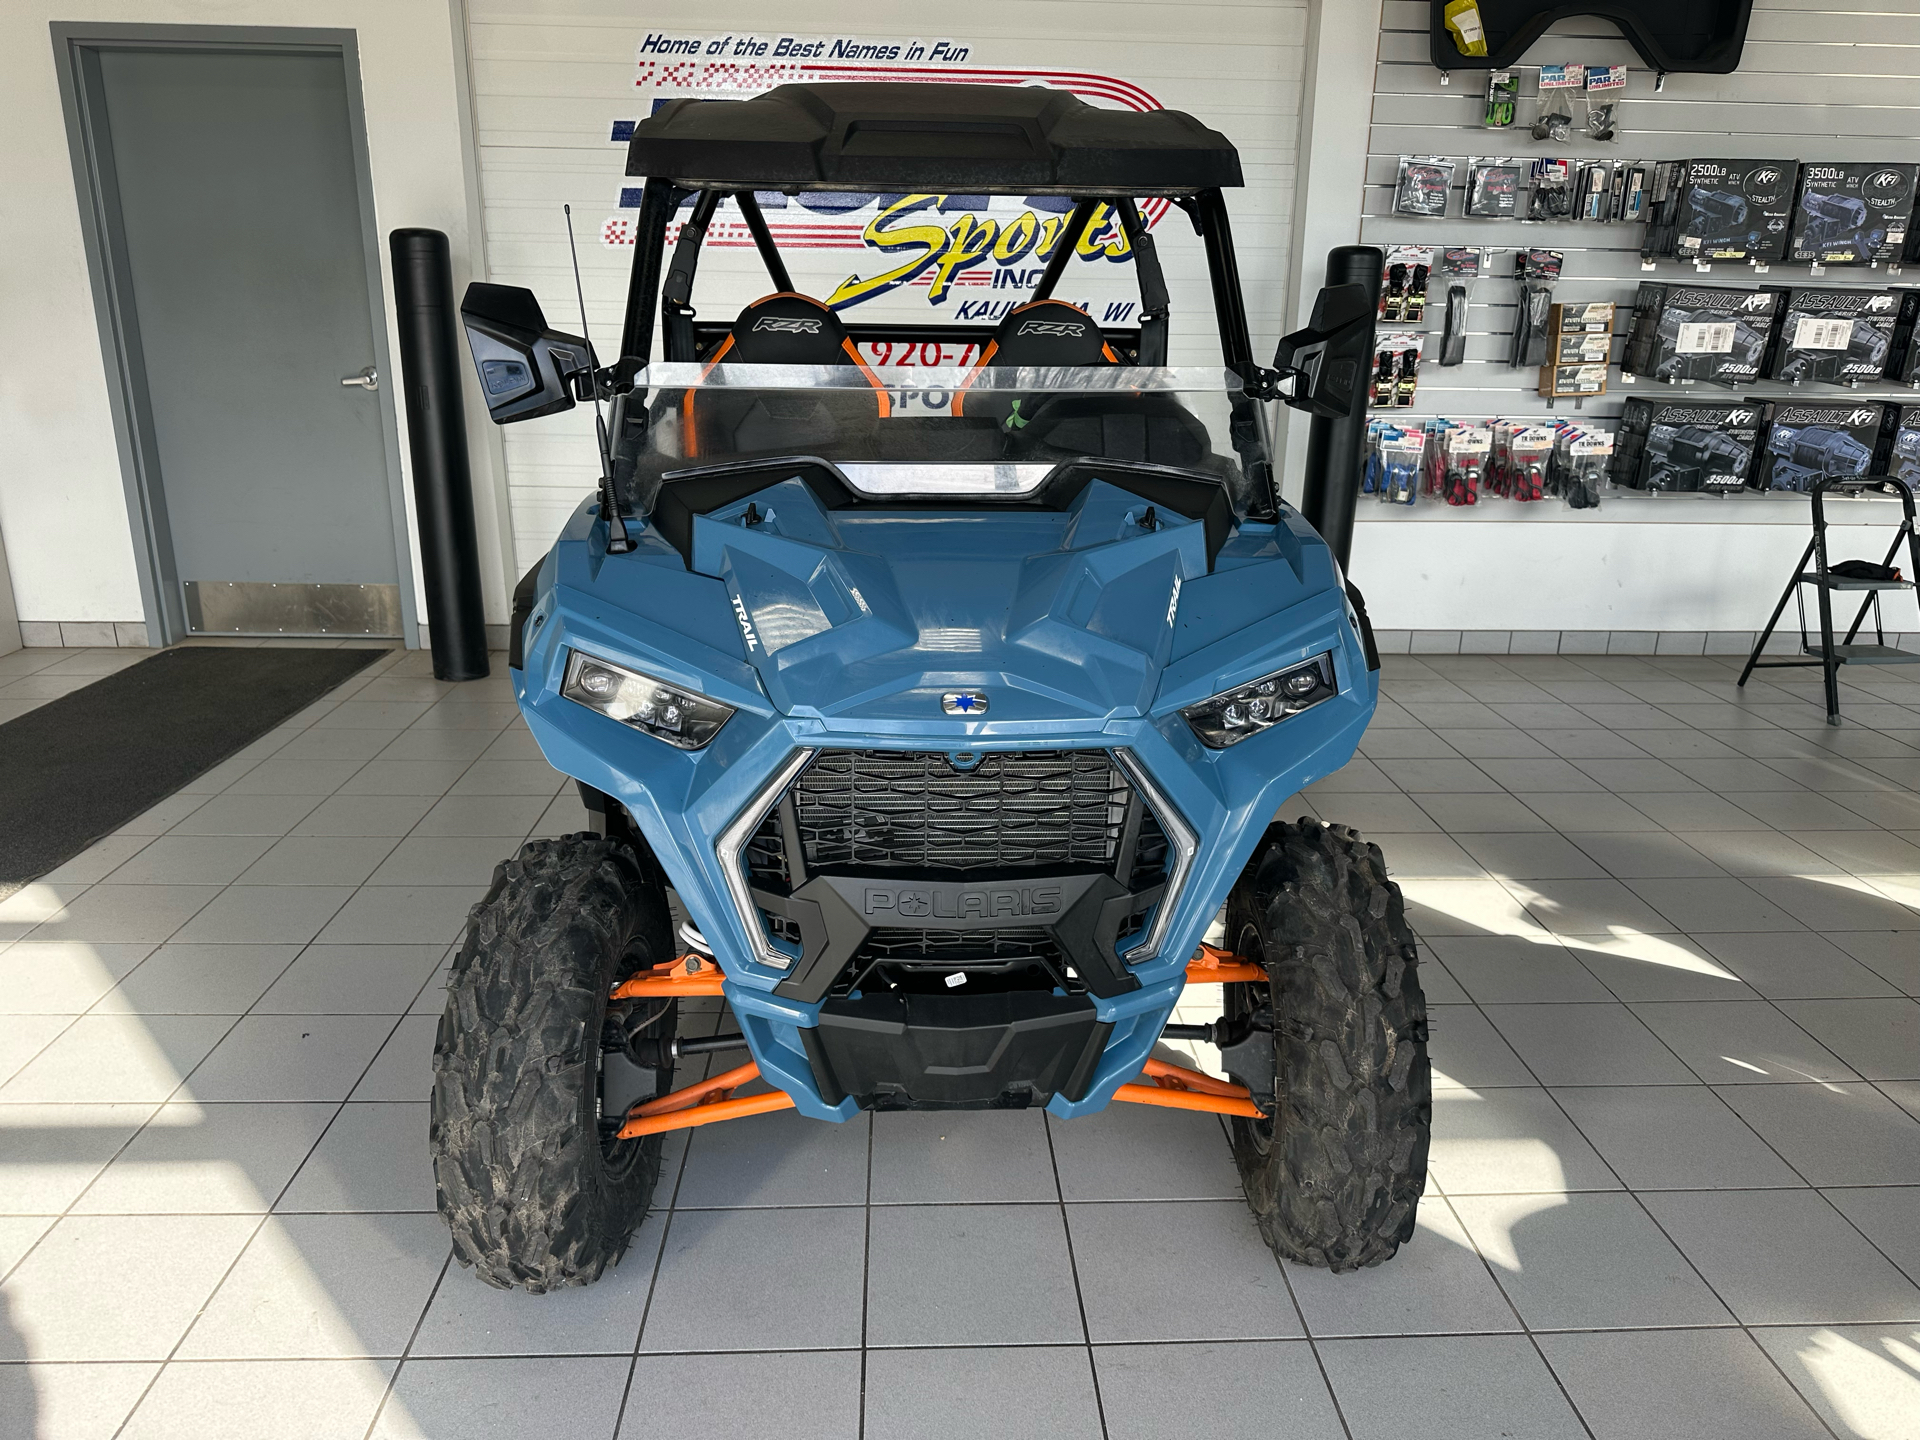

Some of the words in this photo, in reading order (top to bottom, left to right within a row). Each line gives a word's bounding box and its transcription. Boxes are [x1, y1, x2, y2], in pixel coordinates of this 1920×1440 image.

[640, 34, 700, 54] Home
[706, 37, 733, 56] of
[735, 37, 768, 56] the
[772, 37, 824, 58] Best
[828, 39, 901, 60] Names
[904, 41, 925, 61] in
[928, 42, 970, 62] Fun
[1589, 81, 1624, 90] UNLIMITED
[1690, 164, 1727, 176] 2500LB
[1757, 170, 1778, 183] KFi
[1807, 168, 1844, 179] 3500LB
[1876, 174, 1898, 187] KFi
[1751, 195, 1776, 203] STEALTH
[1871, 198, 1896, 206] STEALTH
[825, 193, 1149, 312] Sports
[991, 268, 1045, 289] INC
[1667, 289, 1744, 309] ASSAULT
[1790, 292, 1868, 311] ASSAULT
[1102, 302, 1135, 321] WI
[752, 316, 824, 334] RZR
[1016, 320, 1087, 338] RZR
[1718, 363, 1759, 375] 2500LB
[1842, 363, 1882, 374] 2500LB
[1652, 406, 1730, 424] ASSAULT
[1725, 409, 1753, 425] KFi
[1775, 407, 1851, 424] ASSAULT
[1847, 409, 1875, 425] KFi
[1707, 474, 1745, 485] 3500LB
[1166, 573, 1182, 629] TRAIL
[730, 593, 758, 652] TRAIL
[864, 886, 1062, 919] POLARIS
